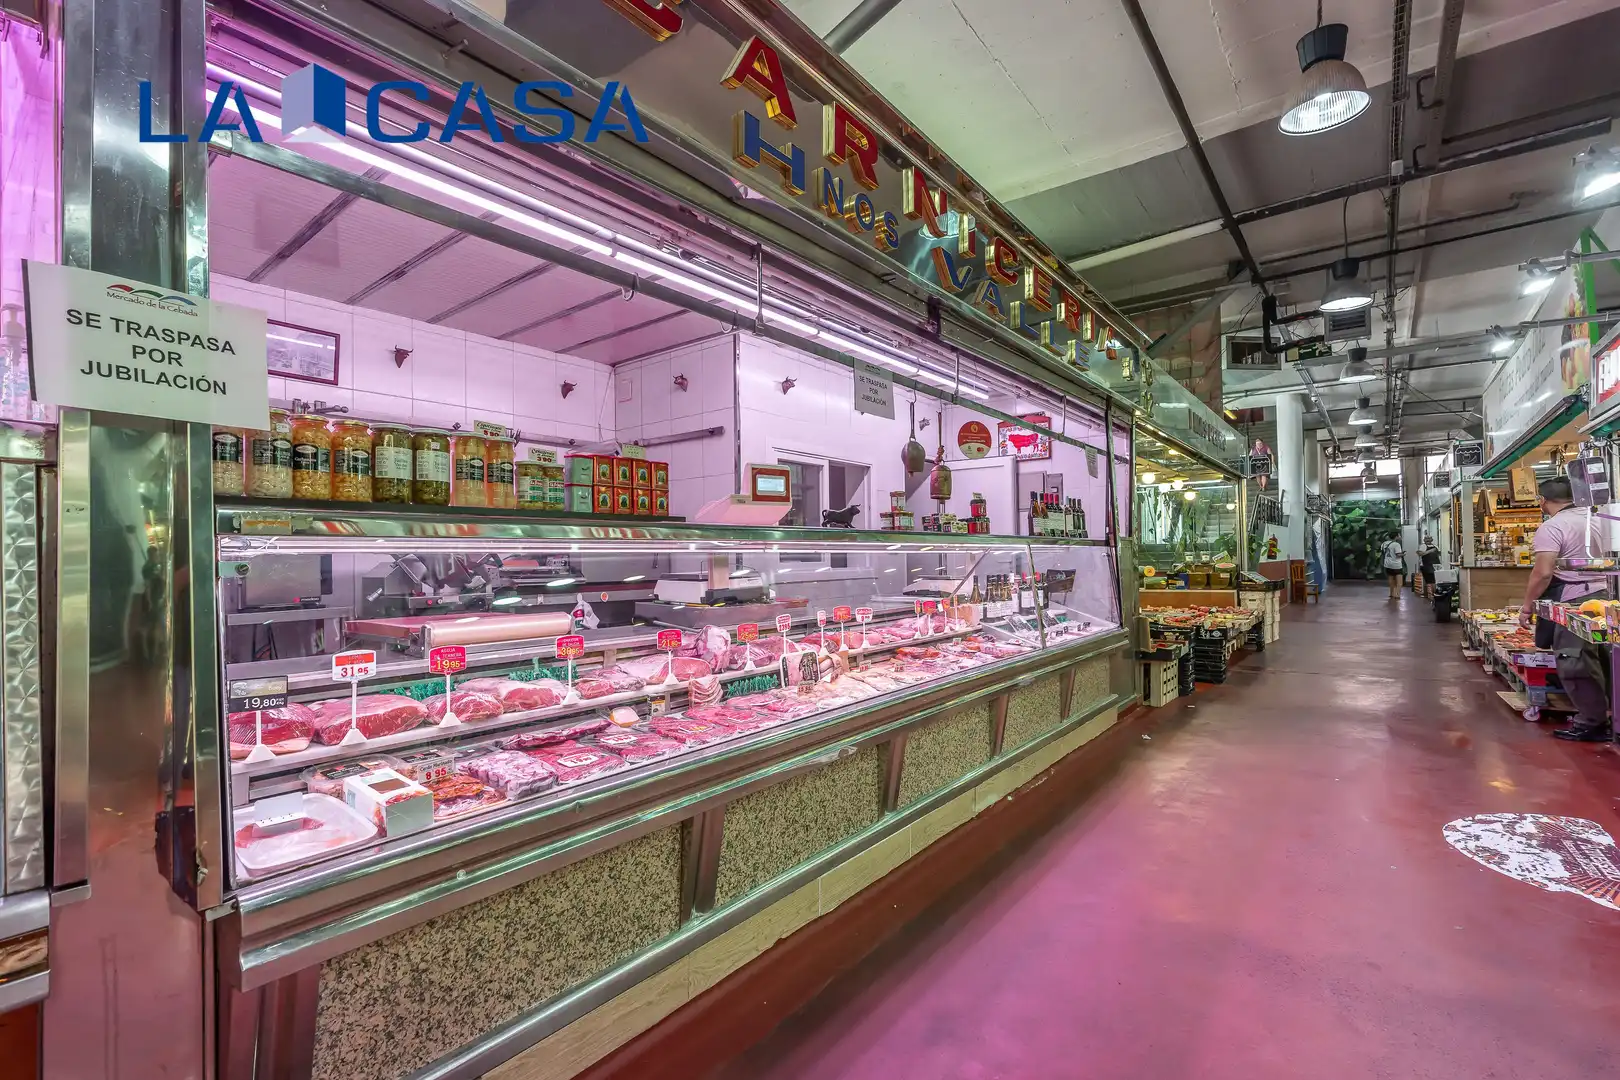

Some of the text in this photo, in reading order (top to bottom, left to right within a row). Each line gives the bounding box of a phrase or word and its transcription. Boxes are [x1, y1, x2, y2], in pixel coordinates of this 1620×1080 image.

[607, 0, 1117, 360] ARNICERIA
[732, 110, 1090, 373] HNOS VALLE
[107, 291, 145, 306] Mercado
[146, 300, 157, 309] de
[167, 304, 199, 317] Cebada
[66, 308, 236, 356] SE TRASPASA
[132, 344, 183, 367] POR
[80, 360, 227, 396] JUBILACIÓN
